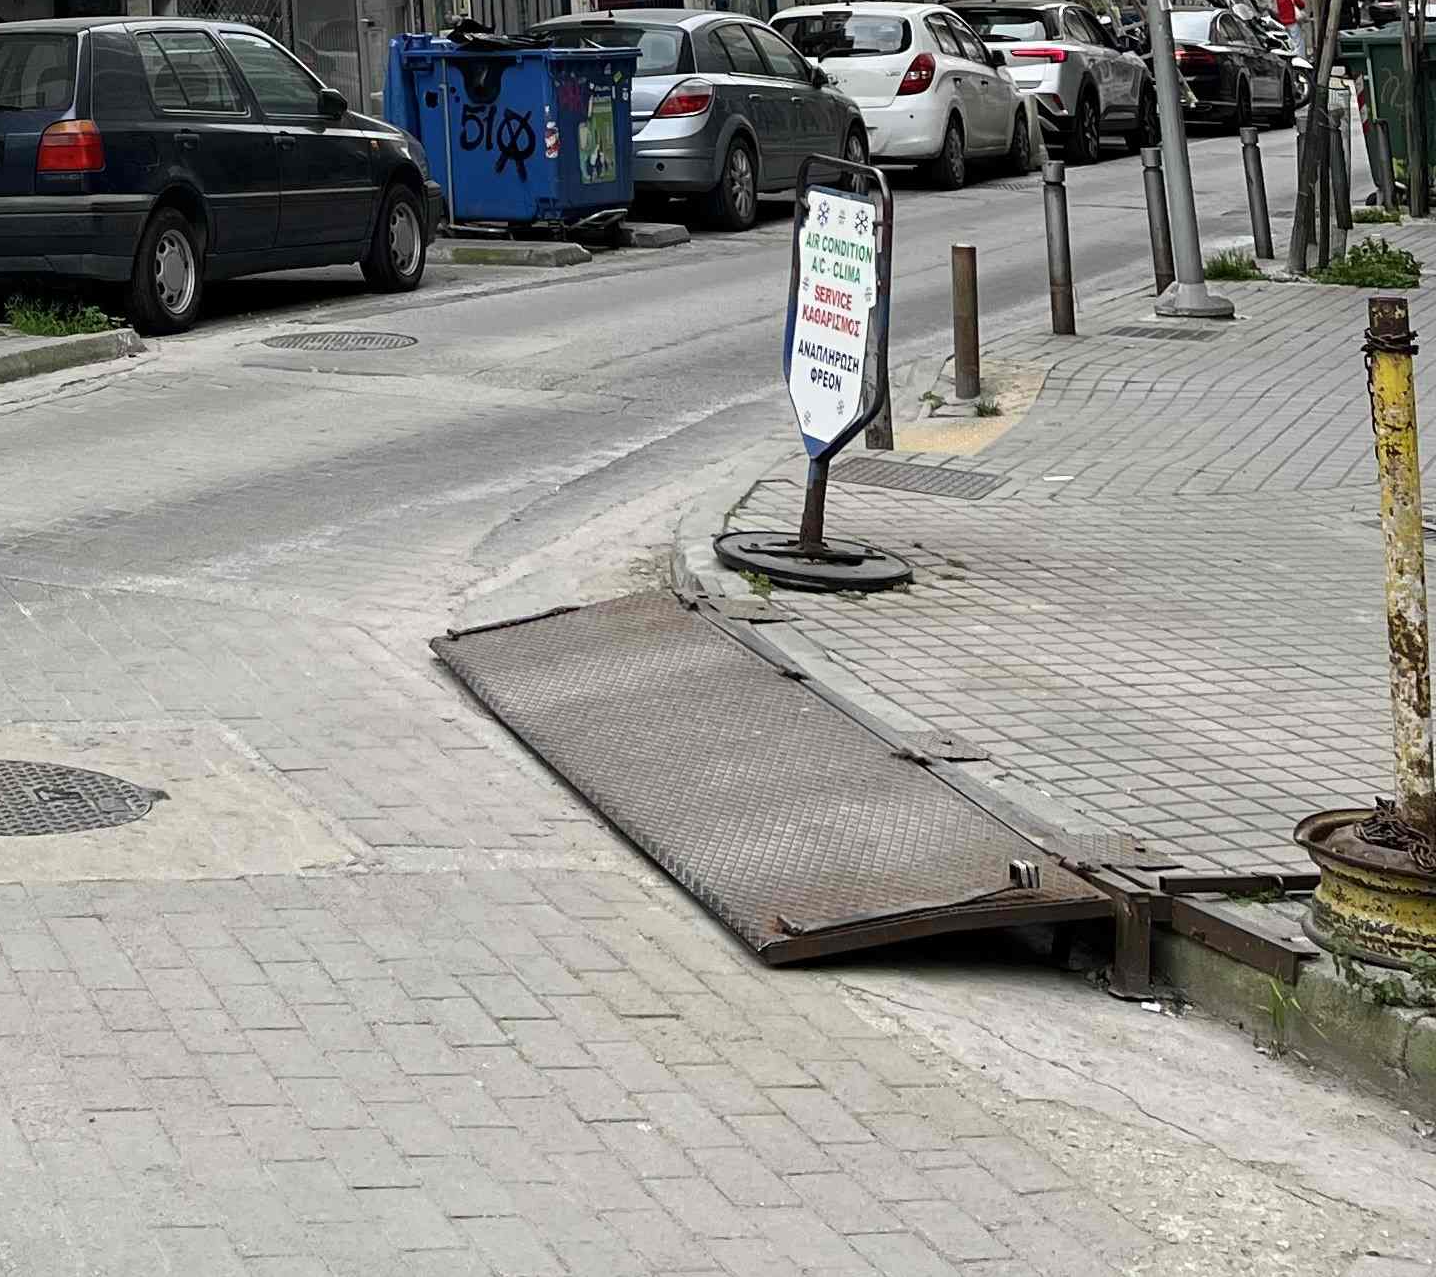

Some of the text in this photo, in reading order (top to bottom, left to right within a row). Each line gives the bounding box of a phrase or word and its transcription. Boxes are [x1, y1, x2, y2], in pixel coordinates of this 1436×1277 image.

[805, 231, 873, 264] AIR CONDITION
[833, 261, 861, 284] CLIMA
[814, 285, 853, 311] SERVICE
[802, 304, 861, 337] ΚΑΘΑΡΙΣΜΟΣ
[798, 339, 860, 375] ΑΝΑΠΛΗΡΩΣΗ
[810, 367, 842, 392] ΦΡΕΟΝ
